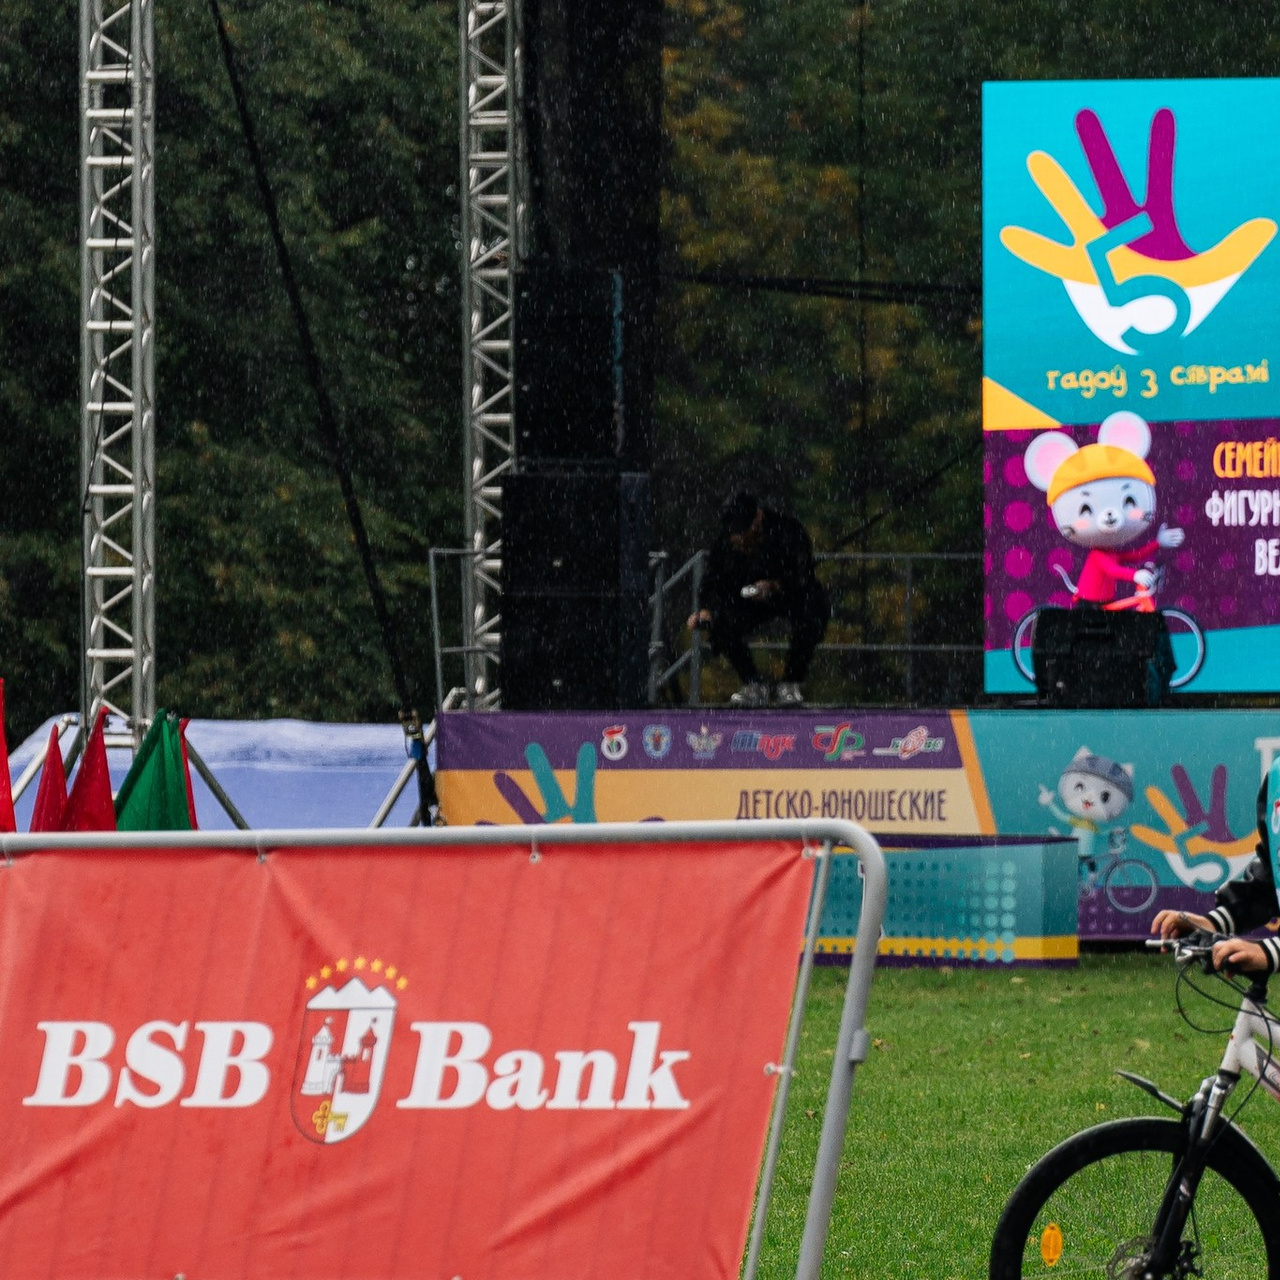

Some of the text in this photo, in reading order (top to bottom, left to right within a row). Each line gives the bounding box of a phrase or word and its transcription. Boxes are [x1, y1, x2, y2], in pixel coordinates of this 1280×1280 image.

[736, 789, 947, 822] ДЕТСКО-ЮНОШЕСКИЕ
[23, 1020, 690, 1111] BSB Bank
